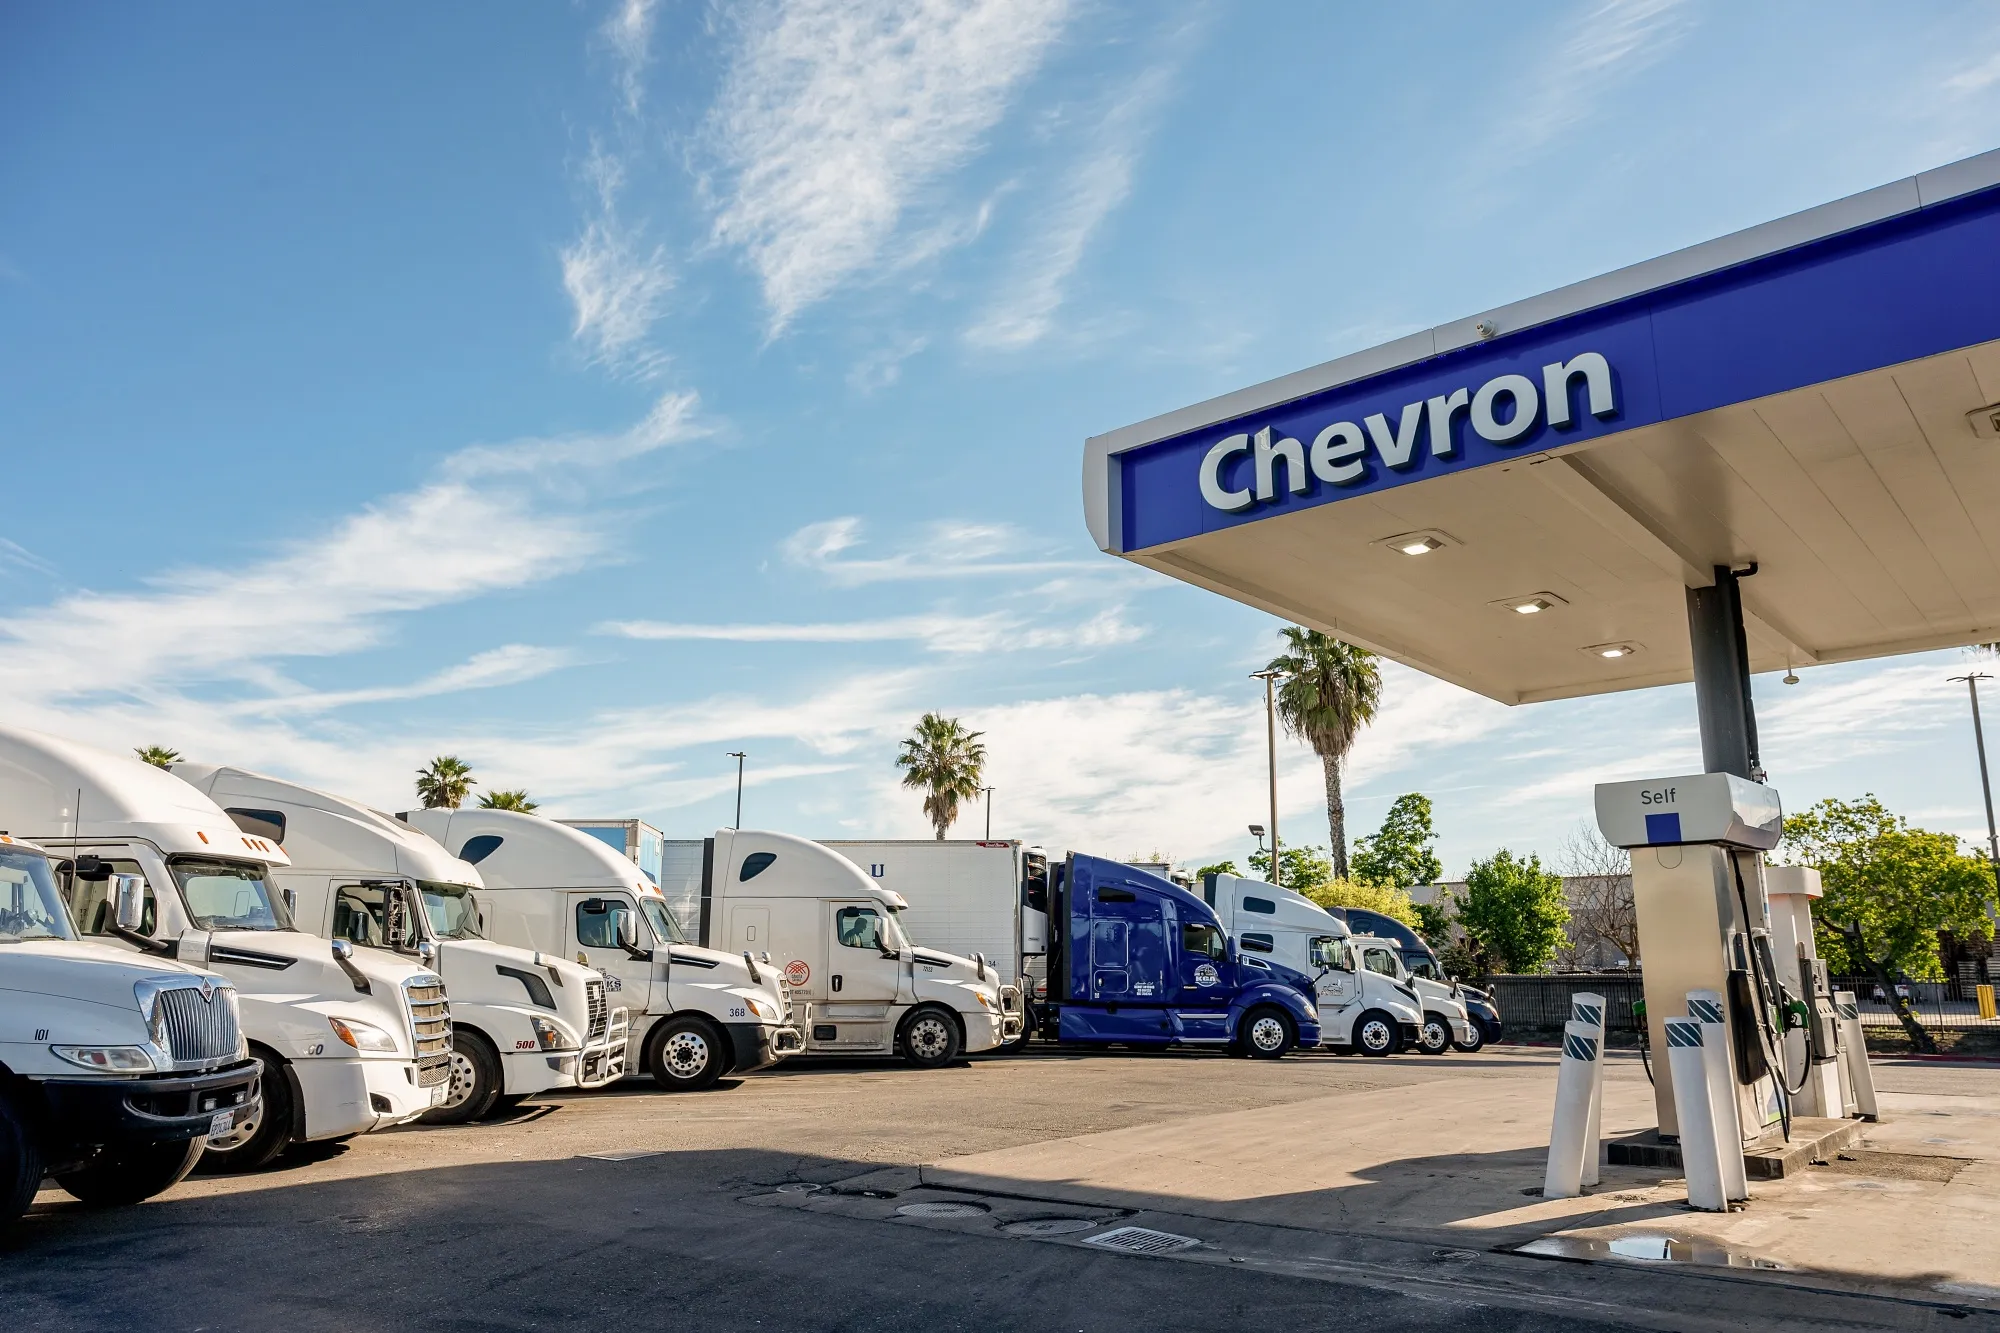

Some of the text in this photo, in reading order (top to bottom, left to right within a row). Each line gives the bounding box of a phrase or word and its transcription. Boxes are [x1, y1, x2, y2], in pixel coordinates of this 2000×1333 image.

[1199, 351, 1617, 512] Chevron
[1641, 787, 1676, 805] Self
[729, 1008, 746, 1018] 368
[34, 1028, 50, 1041] 101
[515, 1040, 536, 1050] 500
